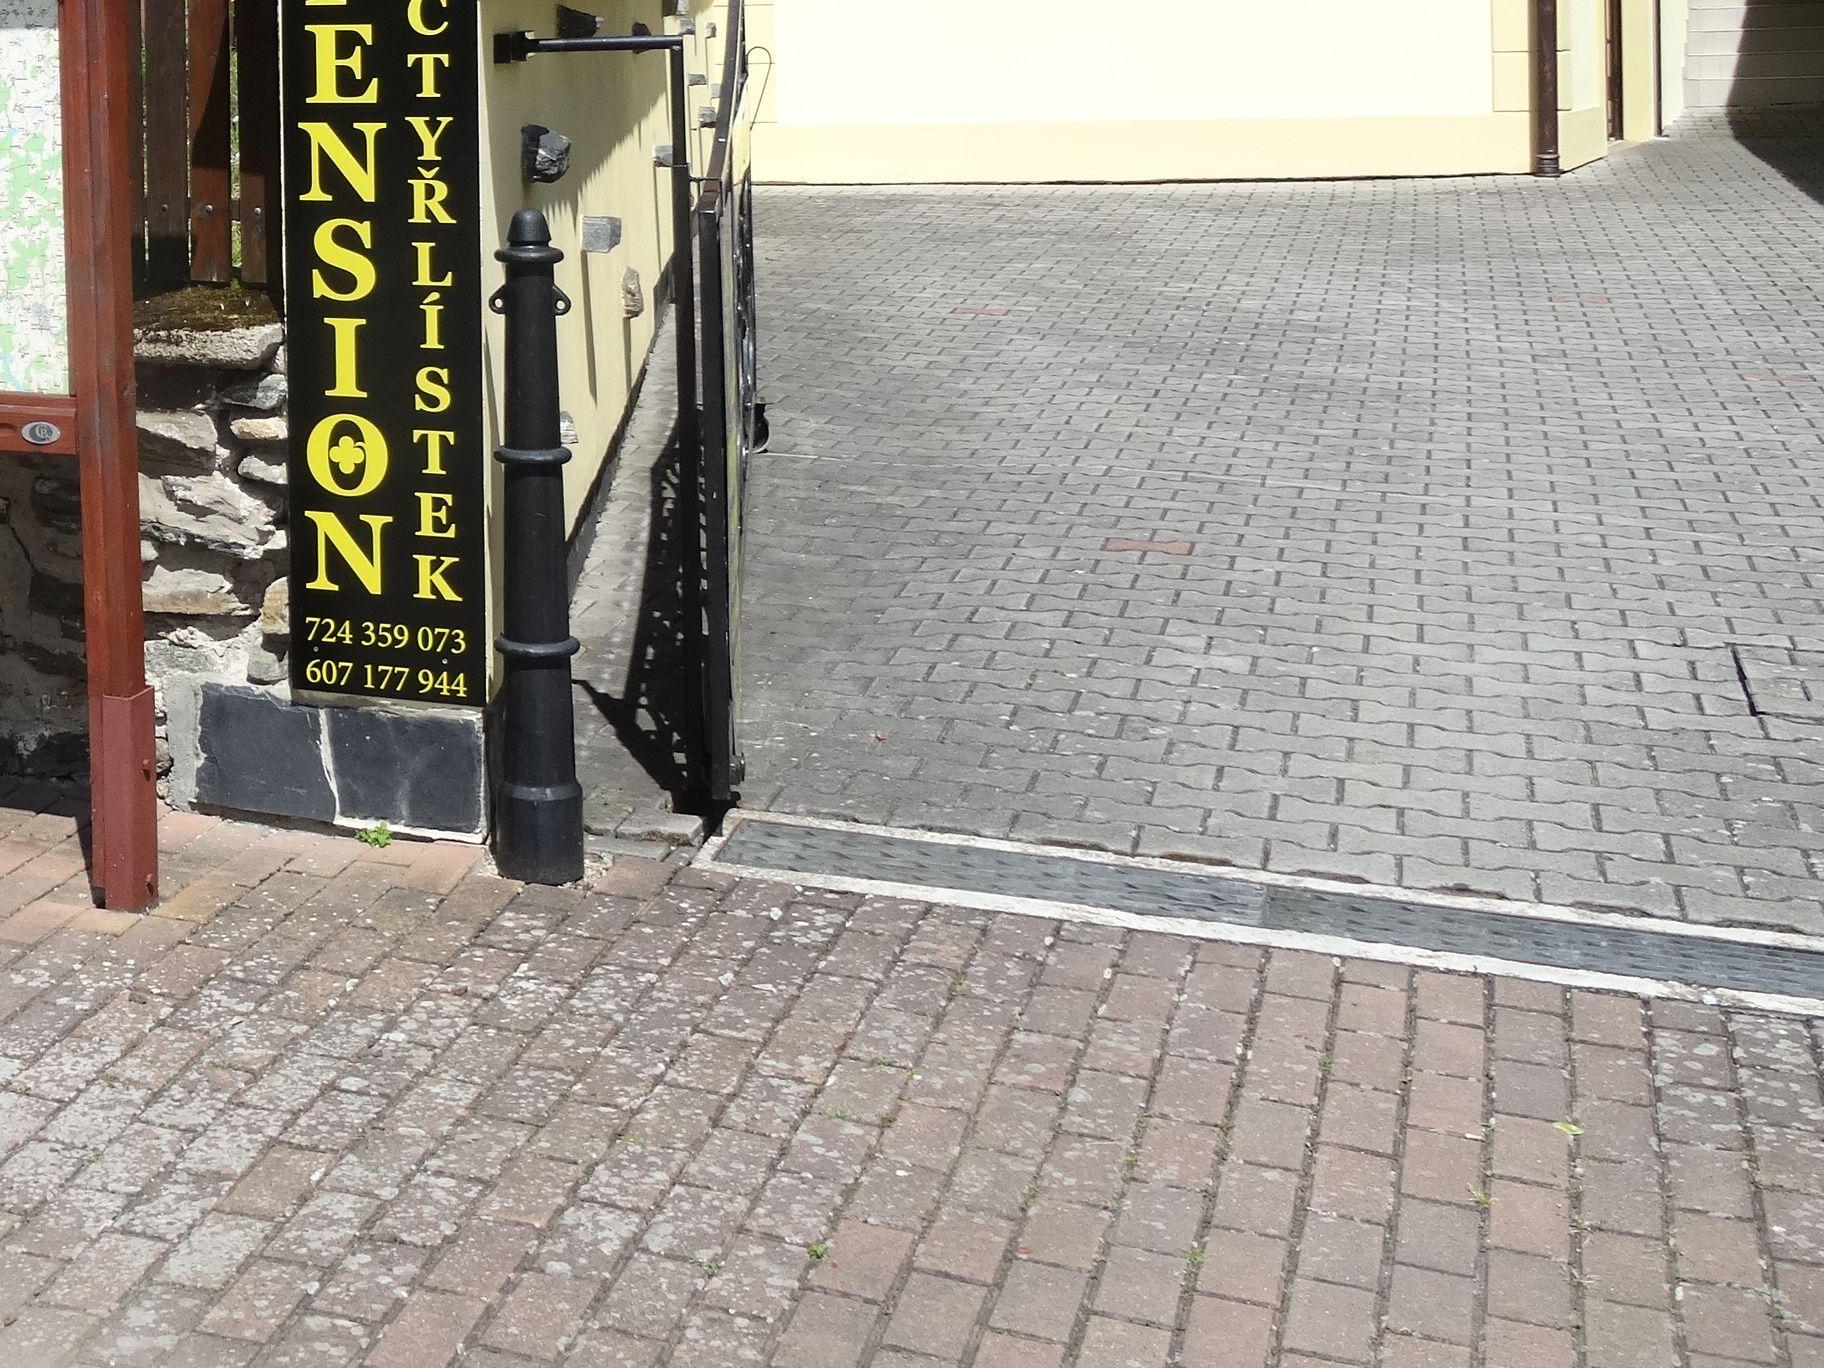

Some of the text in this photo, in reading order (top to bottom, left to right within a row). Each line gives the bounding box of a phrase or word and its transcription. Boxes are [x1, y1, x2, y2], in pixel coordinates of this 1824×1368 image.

[305, 616, 467, 655] 724 359 073
[305, 659, 468, 698] 607 177 944
